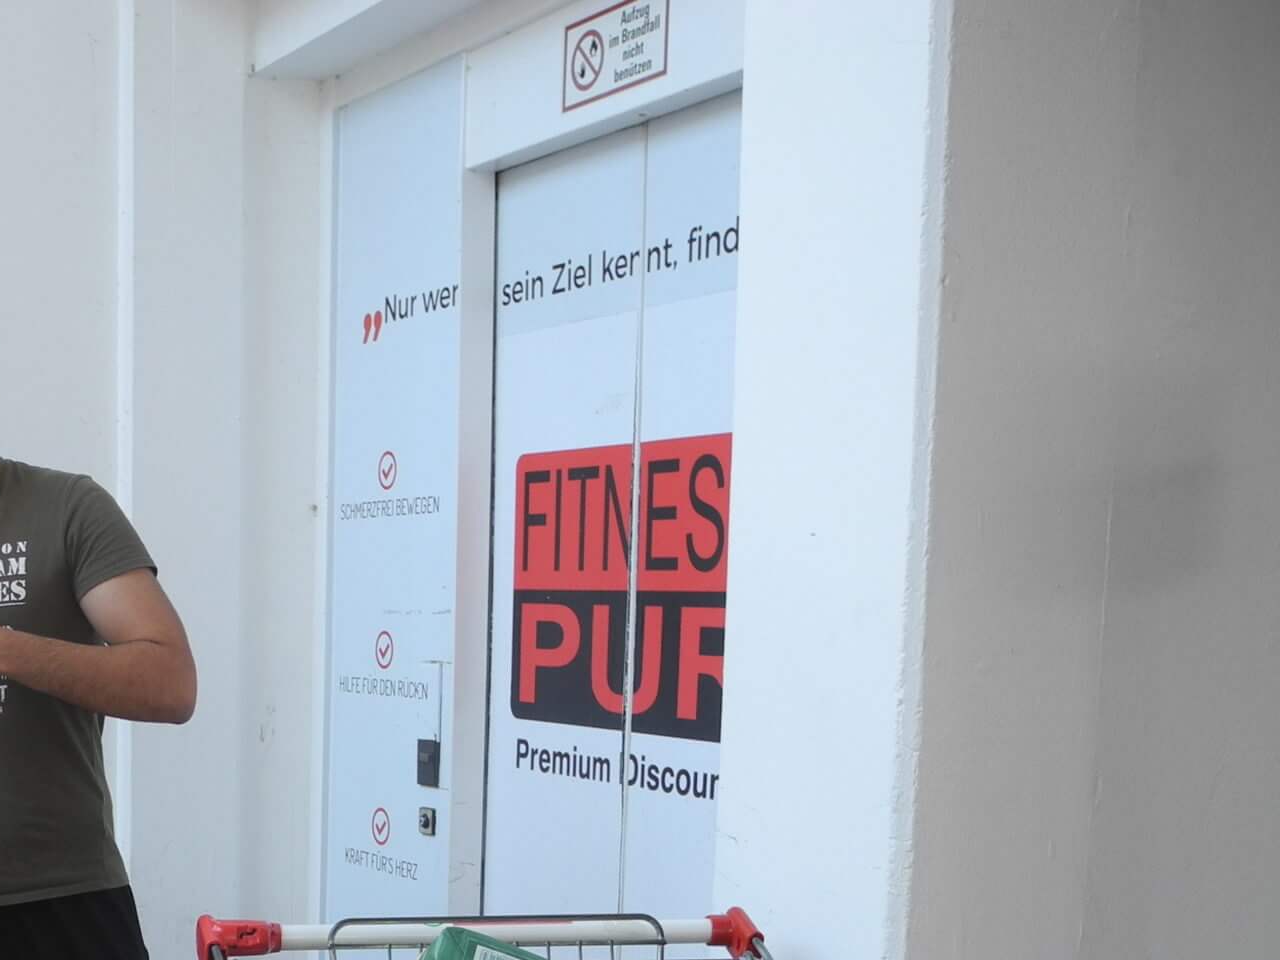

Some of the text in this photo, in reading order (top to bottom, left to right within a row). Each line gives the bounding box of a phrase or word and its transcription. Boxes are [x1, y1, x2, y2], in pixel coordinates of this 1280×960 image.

[620, 4, 650, 27] Aufzug
[609, 14, 661, 48] im Brandfall
[622, 41, 644, 61] nicht
[614, 59, 653, 83] benützen
[384, 294, 418, 324] Nur
[422, 284, 459, 313] wer
[502, 270, 544, 306] sein
[552, 254, 592, 295] Ziel
[687, 215, 740, 263] find
[395, 495, 440, 516] BEWEGEN
[338, 676, 361, 694] HILFE
[362, 674, 378, 696] FÜR
[379, 679, 396, 697] DEN
[515, 738, 611, 783] Premium
[344, 847, 369, 867] KRAFT
[394, 859, 418, 881] HERZ
